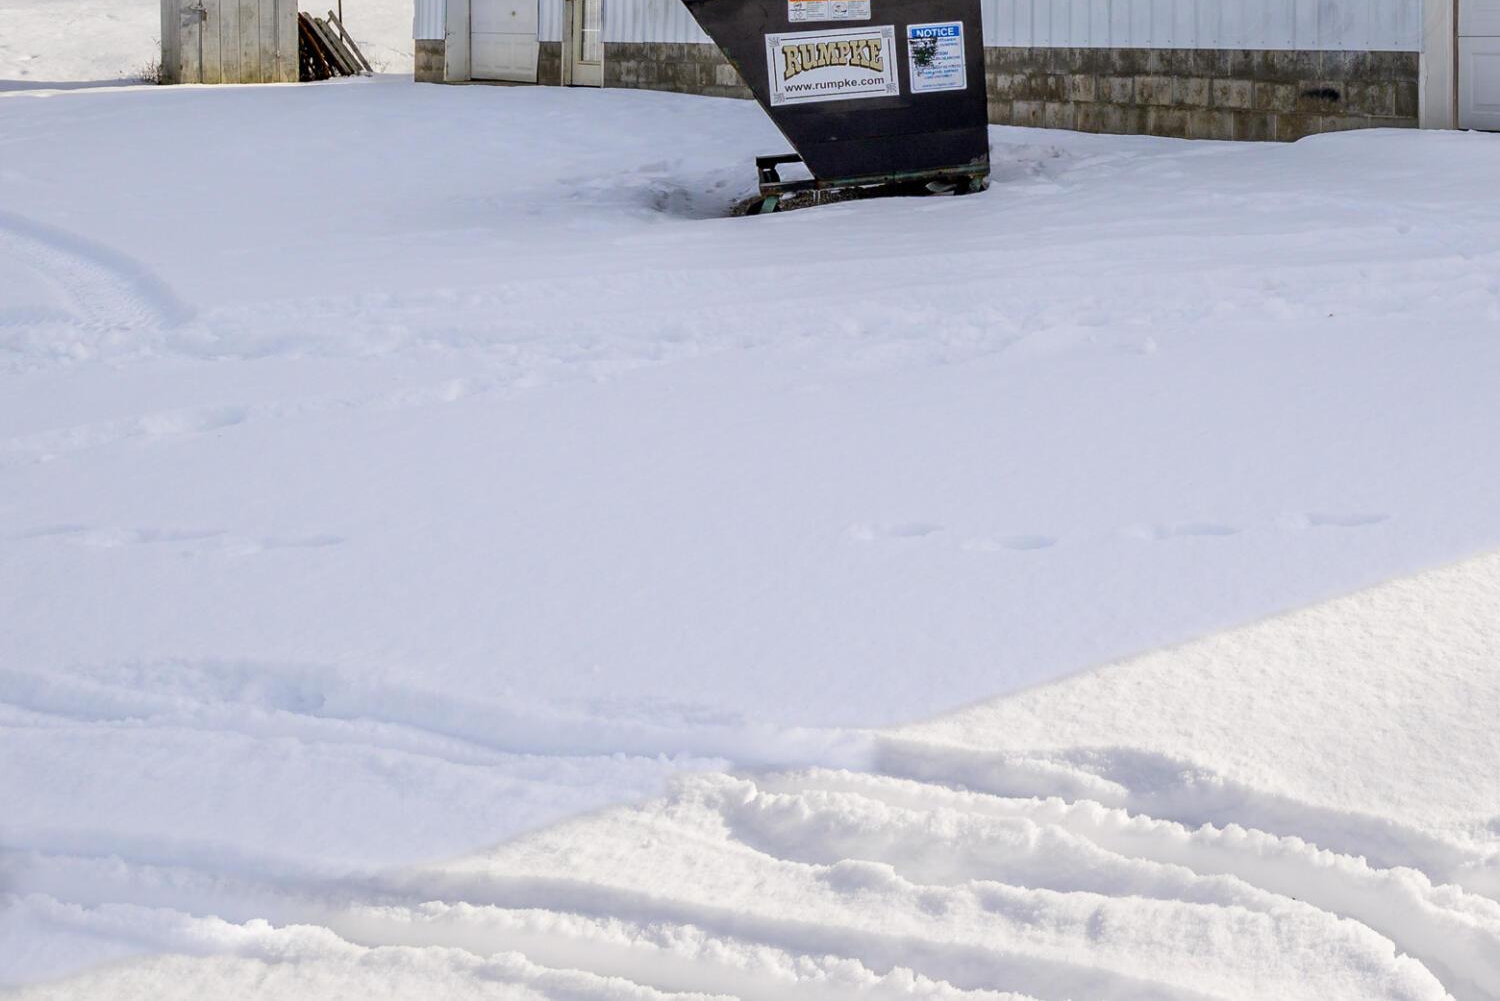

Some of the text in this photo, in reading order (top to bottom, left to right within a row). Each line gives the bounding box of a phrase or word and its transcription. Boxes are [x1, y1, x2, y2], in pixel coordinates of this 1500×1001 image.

[916, 27, 955, 38] NOTICE
[782, 38, 884, 80] RUMPKE
[784, 77, 885, 93] www.rumpke.com
